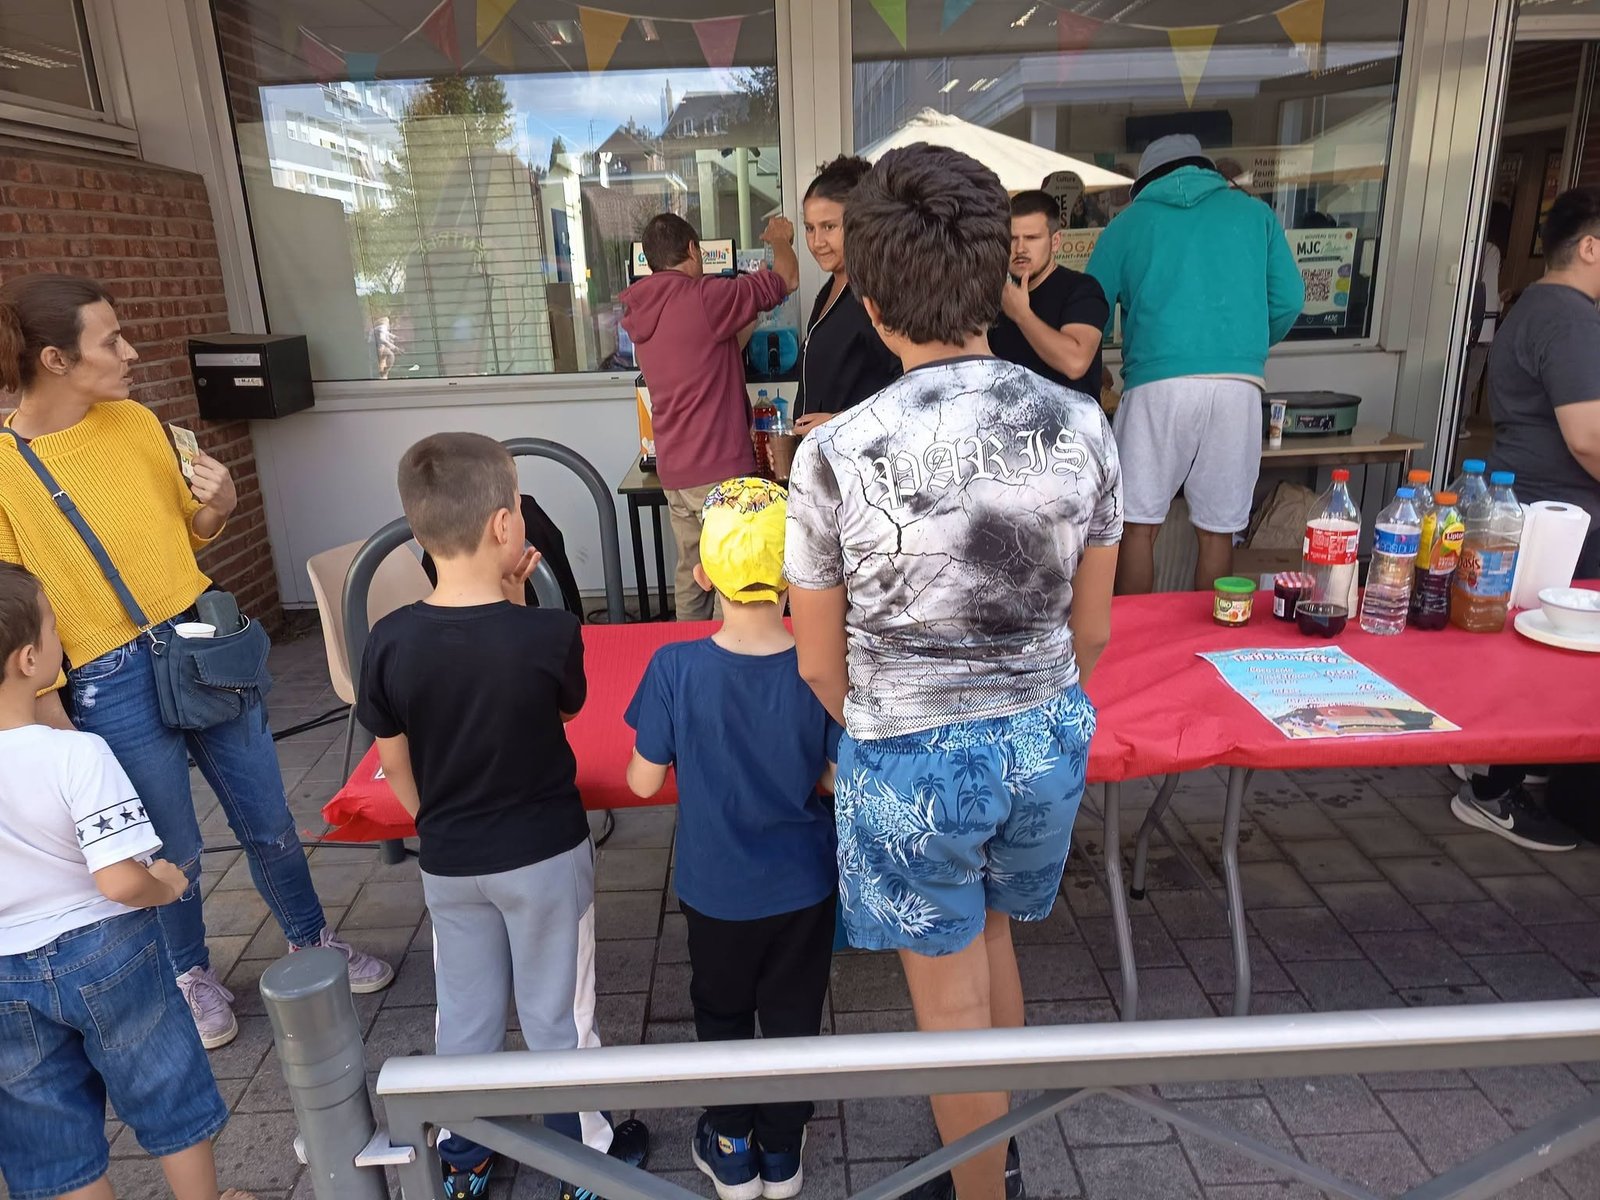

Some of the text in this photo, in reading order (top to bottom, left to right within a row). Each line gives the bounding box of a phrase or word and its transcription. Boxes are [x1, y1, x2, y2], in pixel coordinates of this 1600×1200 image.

[1061, 241, 1095, 253] OGA
[1297, 241, 1321, 255] MJC
[872, 427, 1089, 510] PARIS
[1446, 531, 1464, 540] Lipto
